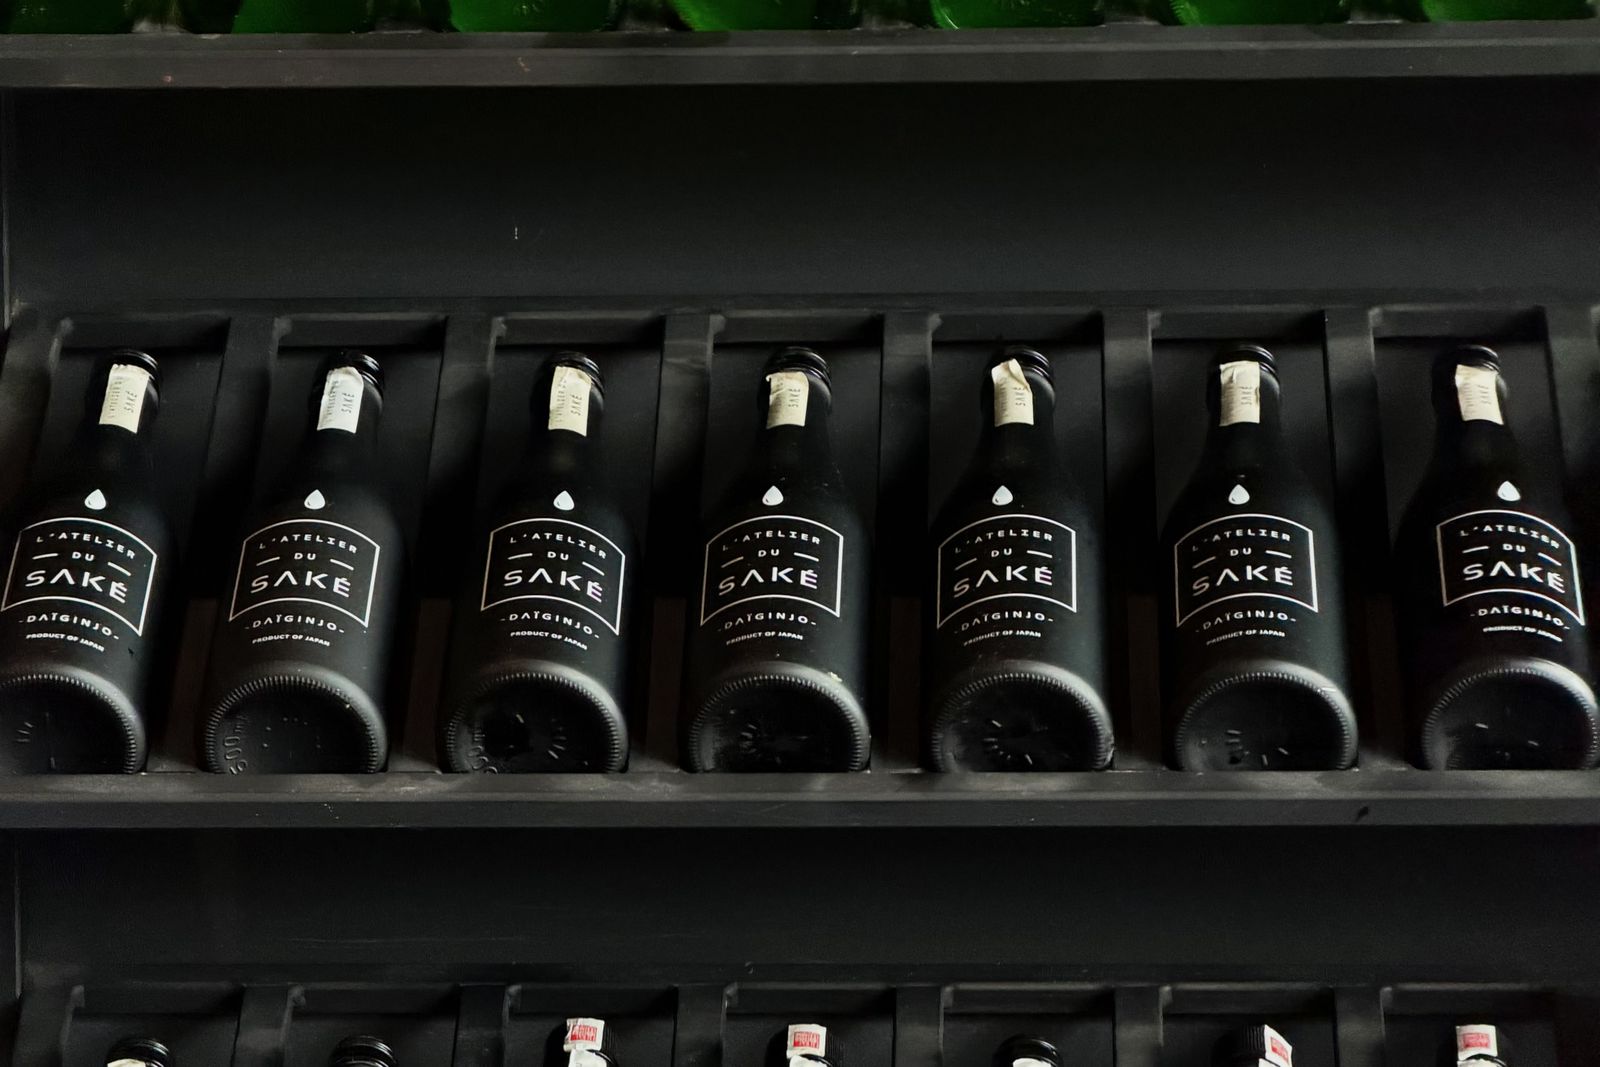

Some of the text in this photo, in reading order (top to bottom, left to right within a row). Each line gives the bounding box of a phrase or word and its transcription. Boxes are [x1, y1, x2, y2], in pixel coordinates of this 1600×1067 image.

[36, 532, 136, 559] L'ATELIER
[259, 534, 357, 554] L'ATELIER
[509, 532, 607, 559] L'ATELIER
[954, 529, 1053, 554] L'ATELIER
[1192, 528, 1291, 552] L'ATELIER
[1460, 524, 1560, 549] L'ATELIER
[71, 551, 95, 562] DU
[294, 552, 316, 560] DU
[547, 551, 569, 561] DU
[758, 549, 780, 557] DU
[991, 548, 1012, 558] DU
[1230, 547, 1252, 556] DU
[1502, 543, 1526, 552] DU
[25, 568, 128, 604] SAKÉ
[250, 570, 351, 598] SAKÉ
[503, 567, 603, 603] SAKÉ
[718, 566, 818, 596] SAKÉ
[953, 565, 1053, 598] SAKÉ
[1191, 565, 1293, 597] SAKÉ
[1462, 561, 1566, 594] SAKÉ
[26, 632, 105, 652] PRODUCT OF JAPAN
[252, 634, 290, 644] PRODUCT
[305, 635, 330, 647] JAPAN
[551, 632, 563, 640] OF
[564, 635, 588, 651] JAPAN
[726, 631, 762, 645] PRODUCT
[777, 631, 803, 640] JAPAN
[963, 631, 1000, 647] PRODUCT
[1015, 629, 1041, 638] JAPAN
[1206, 630, 1243, 646] PRODUCT
[1259, 629, 1285, 637] JAPAN
